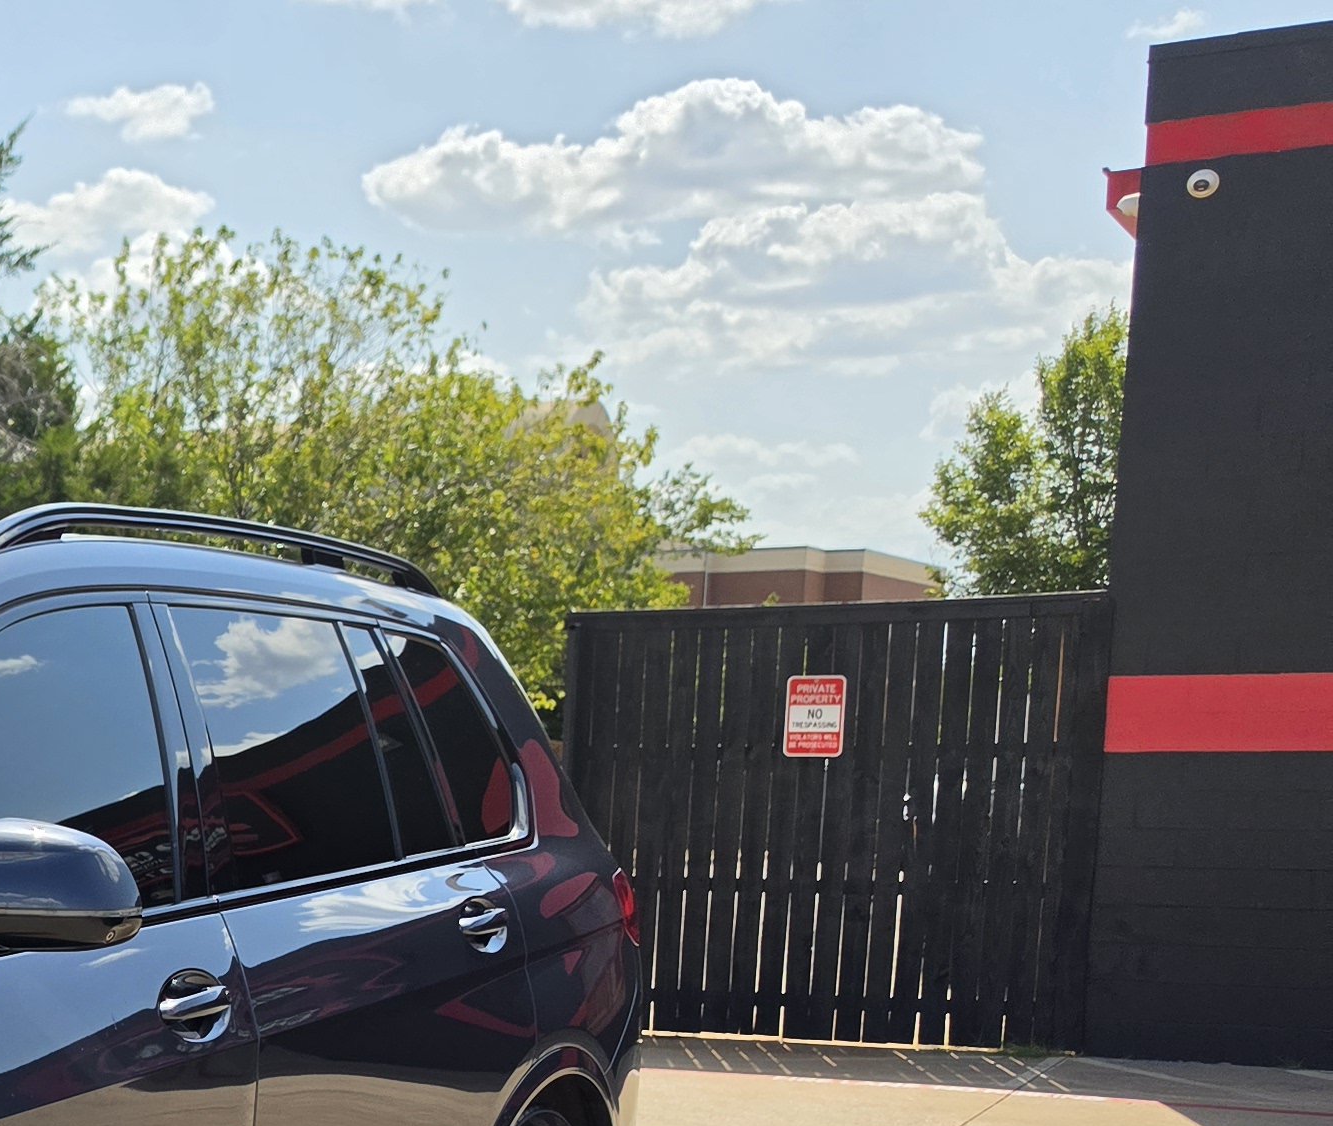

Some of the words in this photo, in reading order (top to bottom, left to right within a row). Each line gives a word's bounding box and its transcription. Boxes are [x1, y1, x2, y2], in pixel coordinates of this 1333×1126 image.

[796, 684, 837, 694] PRIVATE
[790, 694, 842, 705] PROPERTY
[806, 708, 824, 720] NO
[792, 721, 838, 729] TRESPASSING
